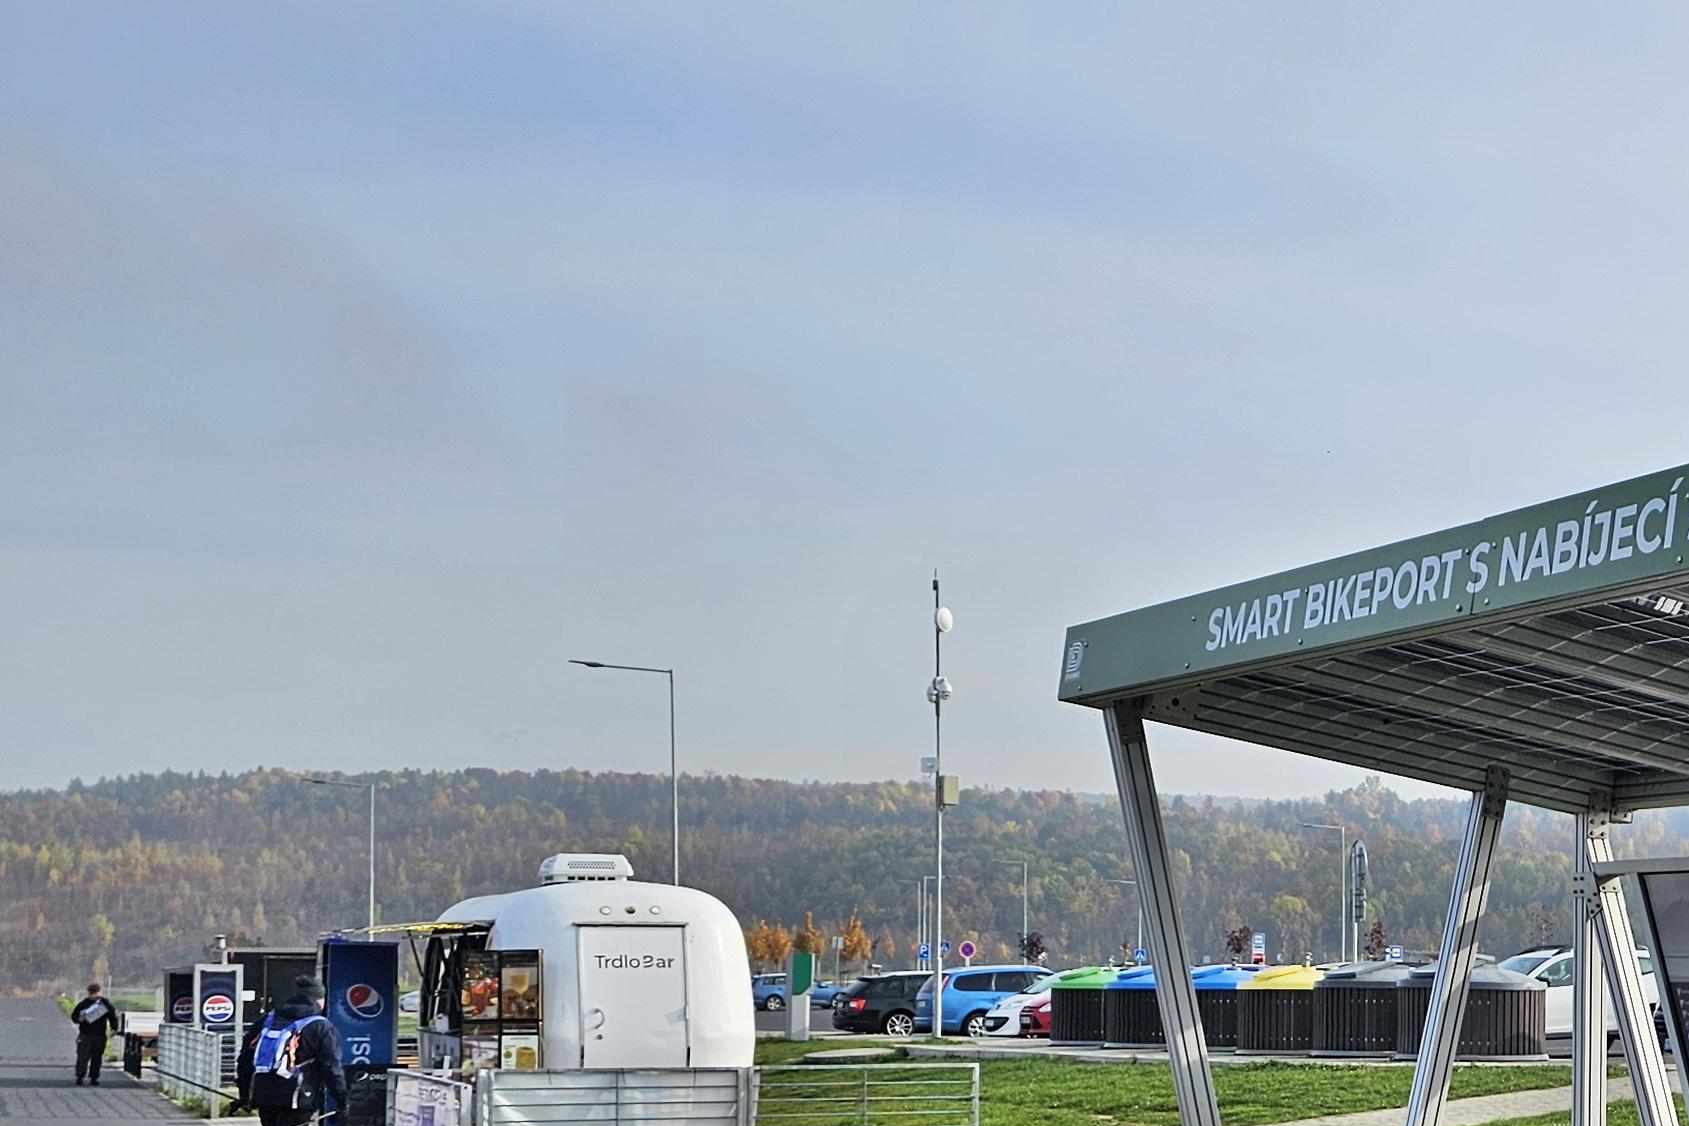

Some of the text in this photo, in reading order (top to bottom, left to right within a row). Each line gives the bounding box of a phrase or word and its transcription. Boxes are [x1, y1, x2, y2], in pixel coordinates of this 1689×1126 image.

[1205, 588, 1300, 651] SMART
[1303, 548, 1463, 630] BIKEPORT
[1466, 541, 1491, 594] S
[1498, 477, 1685, 587] NABÍJECÍ
